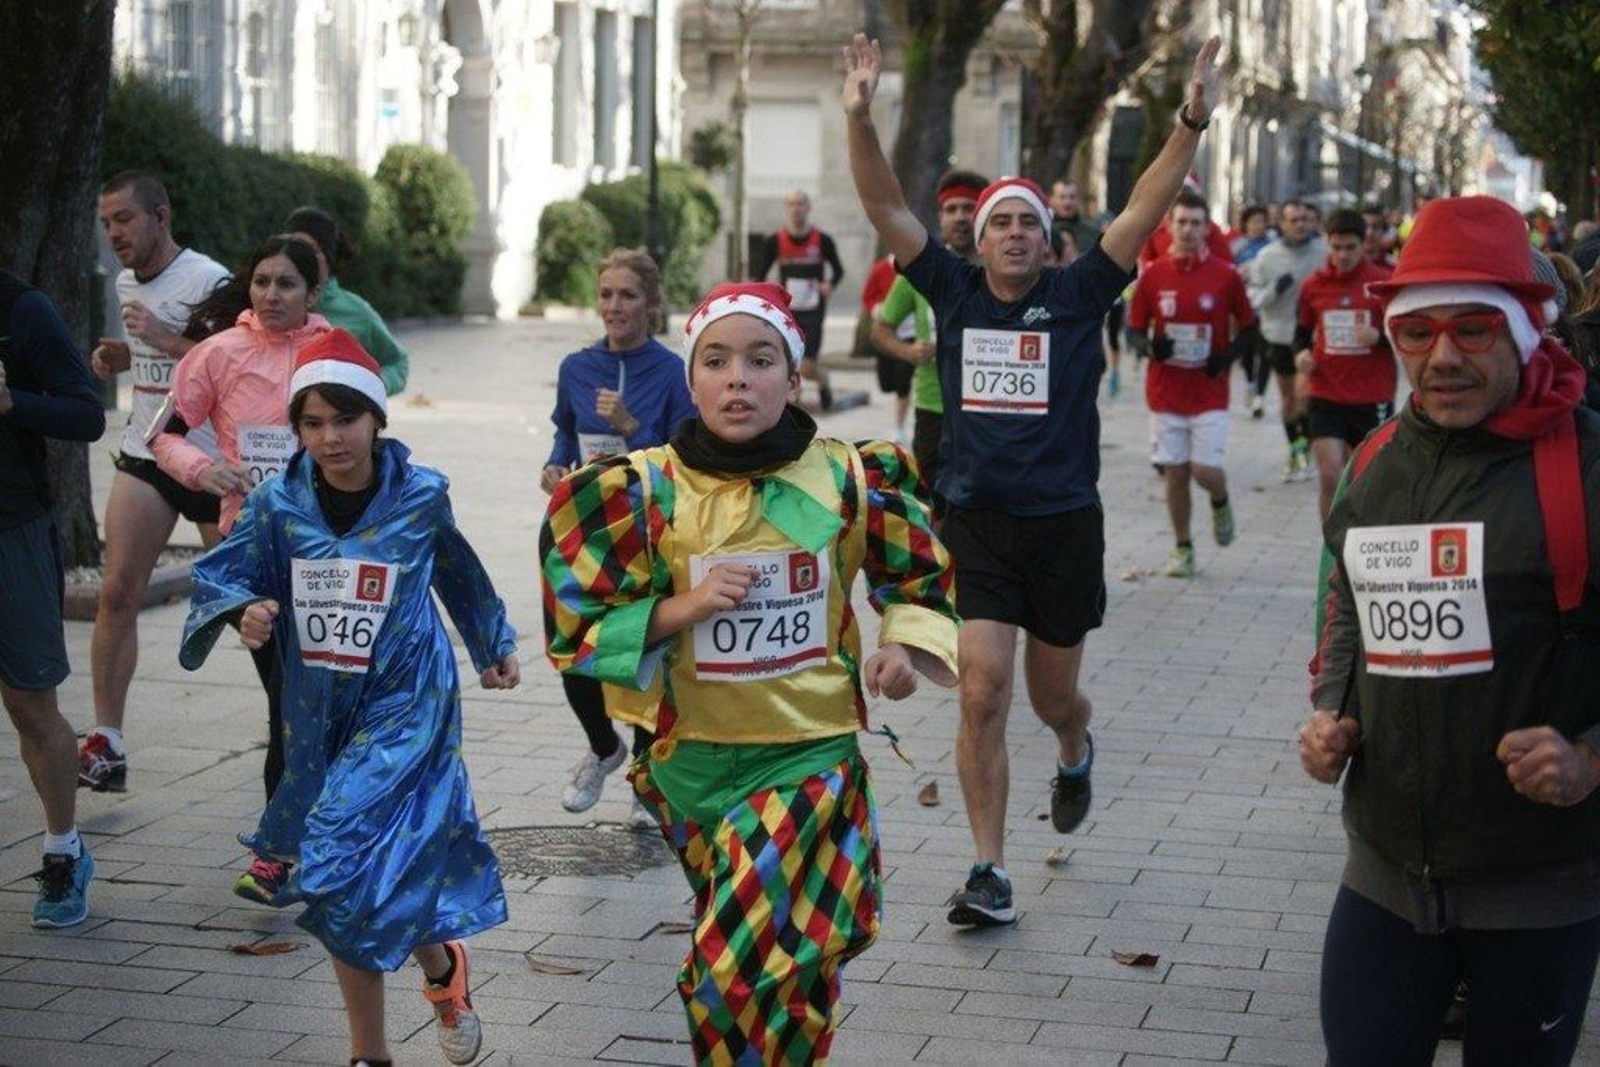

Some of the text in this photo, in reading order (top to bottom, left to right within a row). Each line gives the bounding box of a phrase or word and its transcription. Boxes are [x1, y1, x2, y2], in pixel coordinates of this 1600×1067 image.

[973, 337, 1015, 346] CONCELLO
[976, 345, 1010, 354] DE VIGO
[135, 362, 174, 383] 1107
[972, 370, 1036, 396] 0736
[247, 431, 293, 441] CONCELLO
[252, 441, 287, 450] DE VIGO
[1360, 540, 1420, 554] CONCELLO
[1366, 556, 1413, 569] DE VIGO
[306, 580, 321, 590] DE
[1406, 580, 1448, 594] Viguesa
[1451, 578, 1478, 591] 2014
[765, 597, 804, 610] Viguesa
[1369, 599, 1465, 641] 0896
[712, 611, 811, 653] 0748
